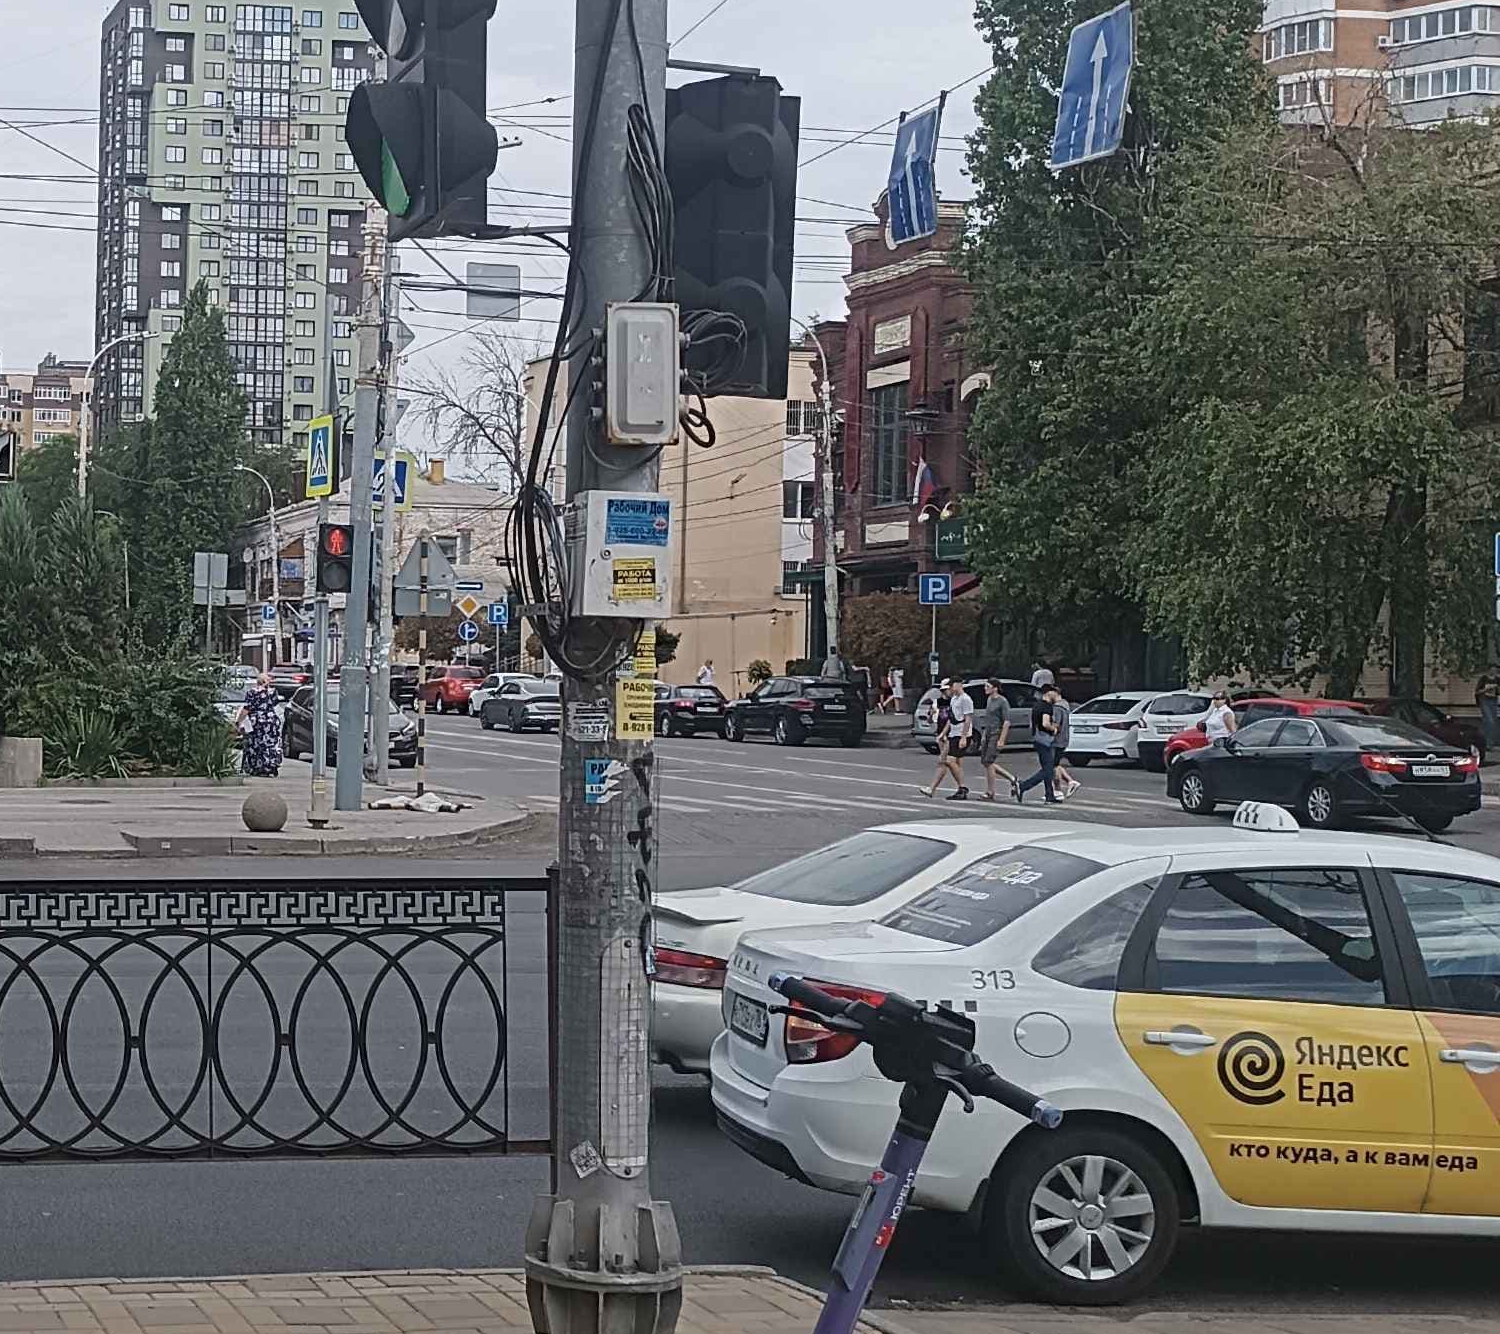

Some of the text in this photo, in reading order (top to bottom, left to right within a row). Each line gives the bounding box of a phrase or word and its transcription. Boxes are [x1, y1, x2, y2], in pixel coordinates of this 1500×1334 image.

[971, 970, 1016, 990] 313
[1295, 1037, 1409, 1070] Яндекс
[1298, 1074, 1354, 1107] Еда
[1229, 1143, 1478, 1172] кто куда, а к вам еда
